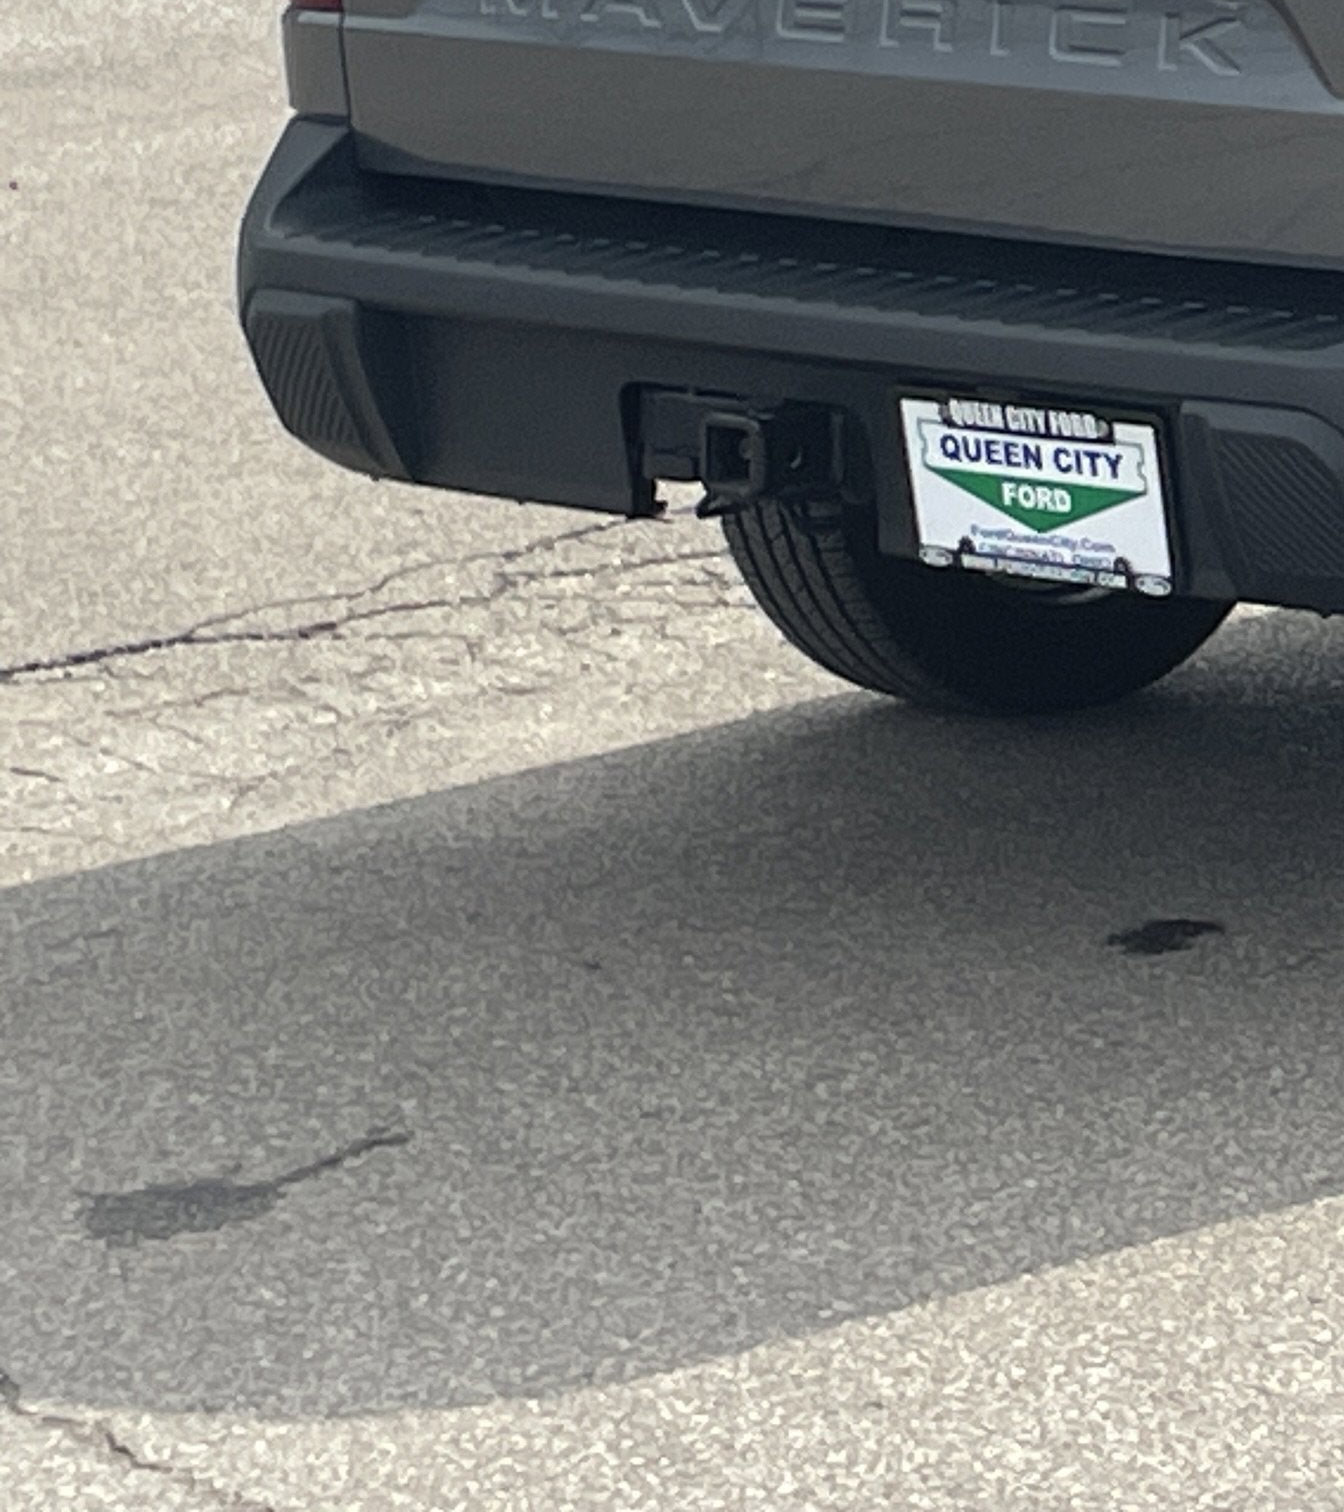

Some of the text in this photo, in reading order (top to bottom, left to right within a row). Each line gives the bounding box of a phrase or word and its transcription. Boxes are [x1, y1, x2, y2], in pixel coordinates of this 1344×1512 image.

[1005, 405, 1047, 434] CITY
[940, 434, 1123, 479] QUEEN CITY
[1002, 482, 1072, 513] FORD
